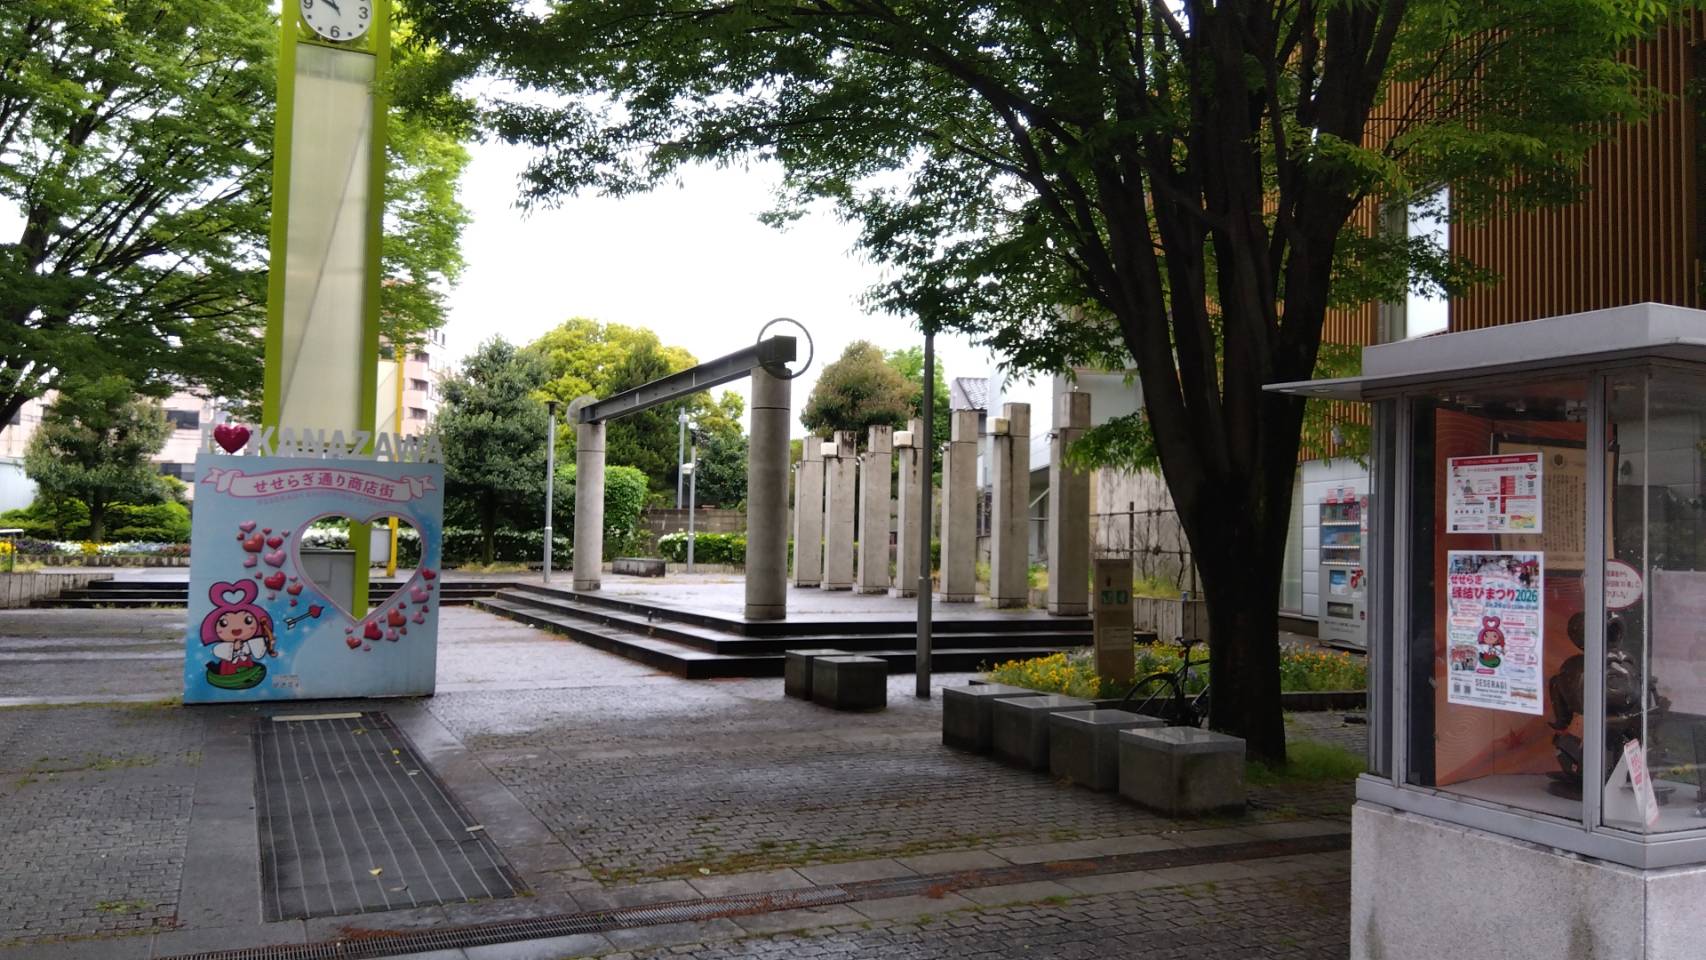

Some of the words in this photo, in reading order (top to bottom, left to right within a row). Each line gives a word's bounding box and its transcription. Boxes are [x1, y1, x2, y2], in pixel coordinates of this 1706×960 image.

[358, 6, 369, 20] 3
[330, 25, 341, 38] 6
[247, 425, 444, 463] KANAZAWA
[254, 471, 395, 498] せせらぎ通り商店街
[1451, 574, 1483, 585] せせらぎ
[1475, 678, 1507, 690] SESERAGI
